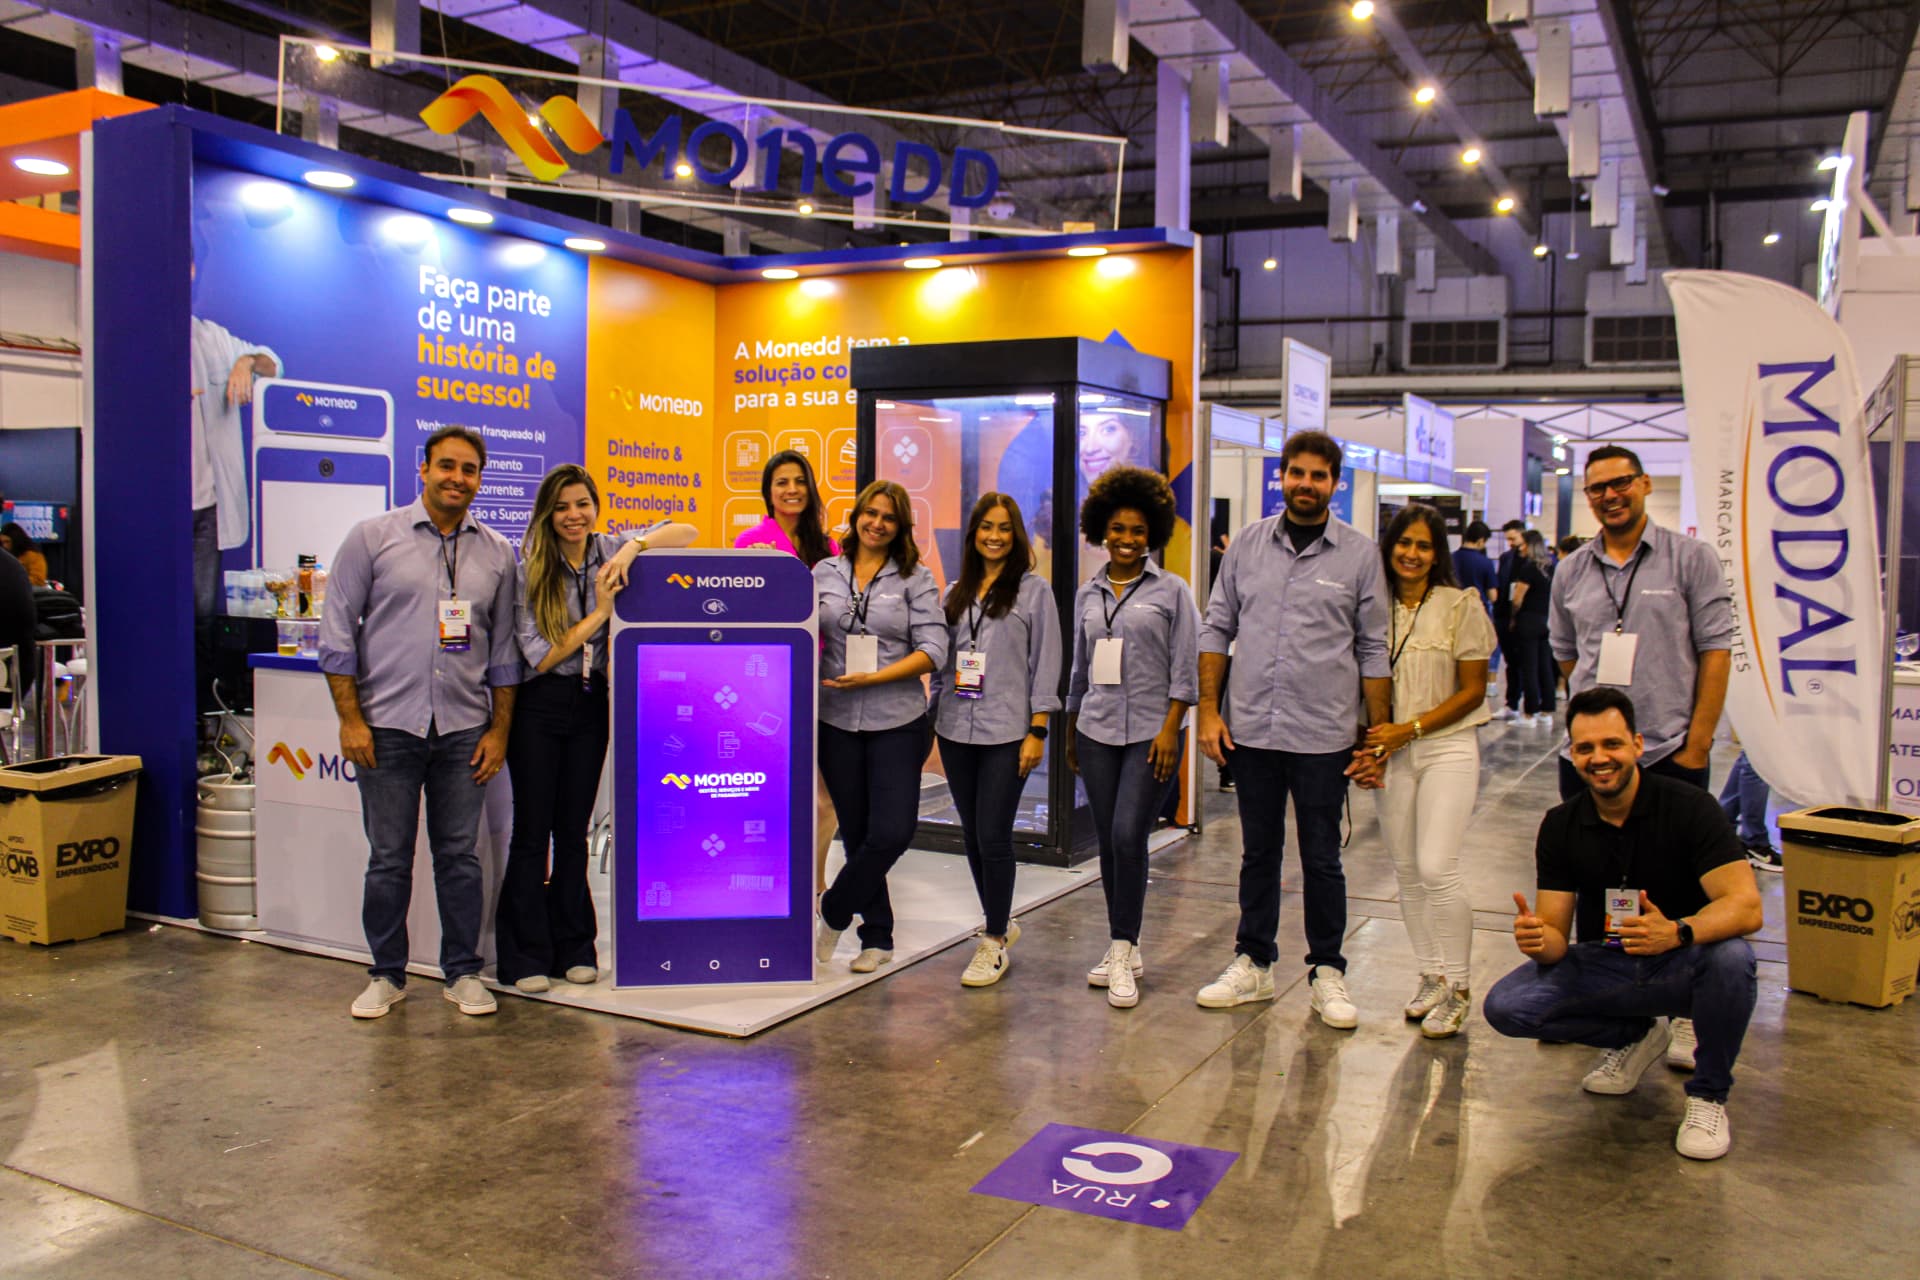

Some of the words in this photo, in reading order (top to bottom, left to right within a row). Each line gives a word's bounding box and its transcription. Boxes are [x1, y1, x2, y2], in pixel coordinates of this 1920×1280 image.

[419, 264, 480, 308] Faça
[488, 284, 552, 317] parte
[418, 300, 452, 332] de
[460, 313, 516, 343] uma
[418, 333, 519, 376] história
[525, 352, 556, 381] de
[734, 341, 750, 360] A
[755, 336, 841, 359] Monedd
[734, 363, 816, 387] solução
[416, 375, 531, 410] sucesso!
[734, 393, 779, 413] para
[785, 391, 797, 407] a
[802, 389, 839, 407] sua
[416, 419, 447, 432] Venh
[482, 425, 533, 441] franqueado
[534, 430, 546, 443] (a)
[607, 438, 670, 461] Dinheiro
[673, 446, 683, 462] &
[607, 466, 689, 488] Pagamento
[692, 472, 702, 488] &
[490, 509, 497, 519] e
[498, 508, 532, 522] Suport
[606, 492, 684, 515] Tecnologia
[687, 497, 697, 512] &
[1716, 469, 1734, 549] MARCAS
[1757, 353, 1858, 698] MODAL
[56, 837, 120, 868] EXPO
[56, 860, 119, 879] EMPREENDEDOR
[1798, 889, 1874, 923] EXPO
[1798, 915, 1874, 936] EMPREENDEDOR
[1062, 1142, 1173, 1185] C
[1052, 1178, 1137, 1208] RUA
